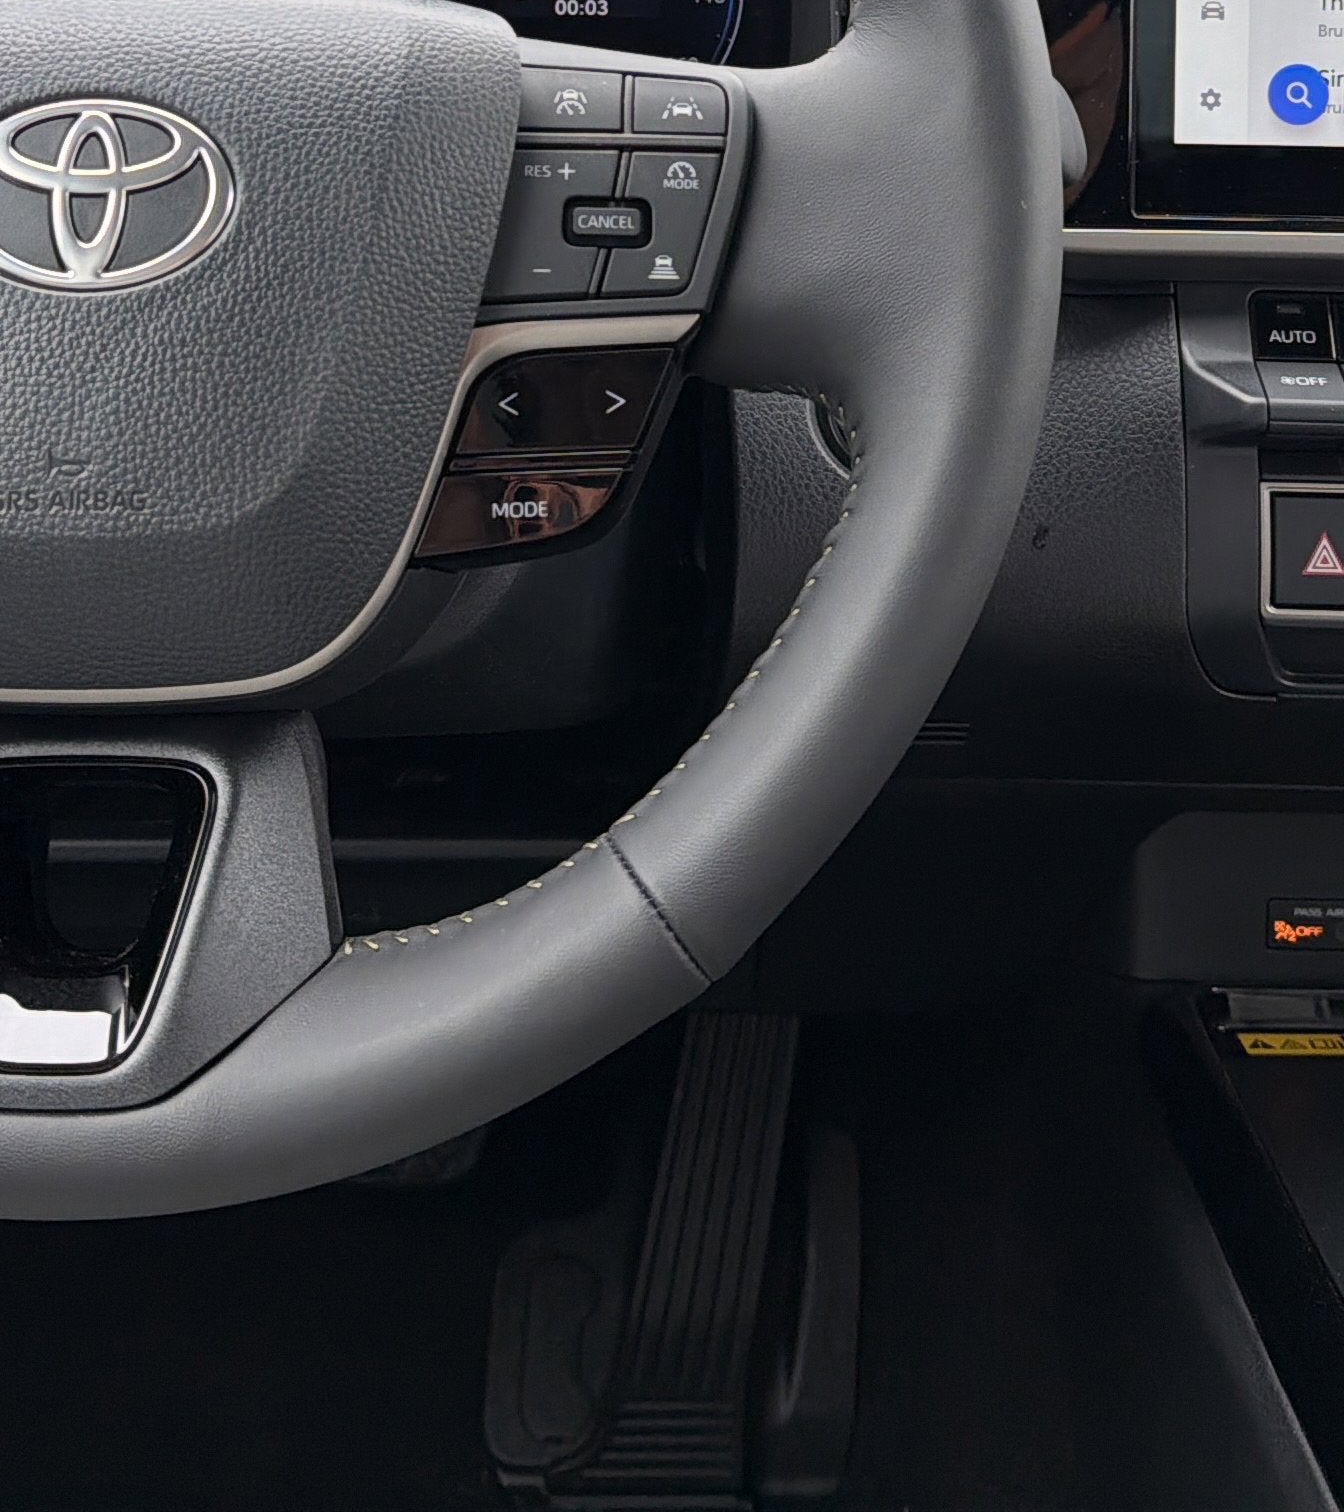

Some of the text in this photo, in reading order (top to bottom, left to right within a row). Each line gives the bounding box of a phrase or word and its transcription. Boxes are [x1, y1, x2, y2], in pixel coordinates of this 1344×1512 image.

[555, 0, 609, 16] 00:03
[524, 165, 551, 178] RES
[663, 179, 700, 190] MODE
[578, 215, 636, 230] CANCEL
[1269, 329, 1317, 345] AUTO
[1296, 376, 1328, 386] OFF
[48, 490, 148, 513] AIRBAG
[492, 501, 549, 518] MODE
[1294, 908, 1322, 917] PASS
[1326, 908, 1344, 917] AIR
[1296, 926, 1323, 936] OFF
